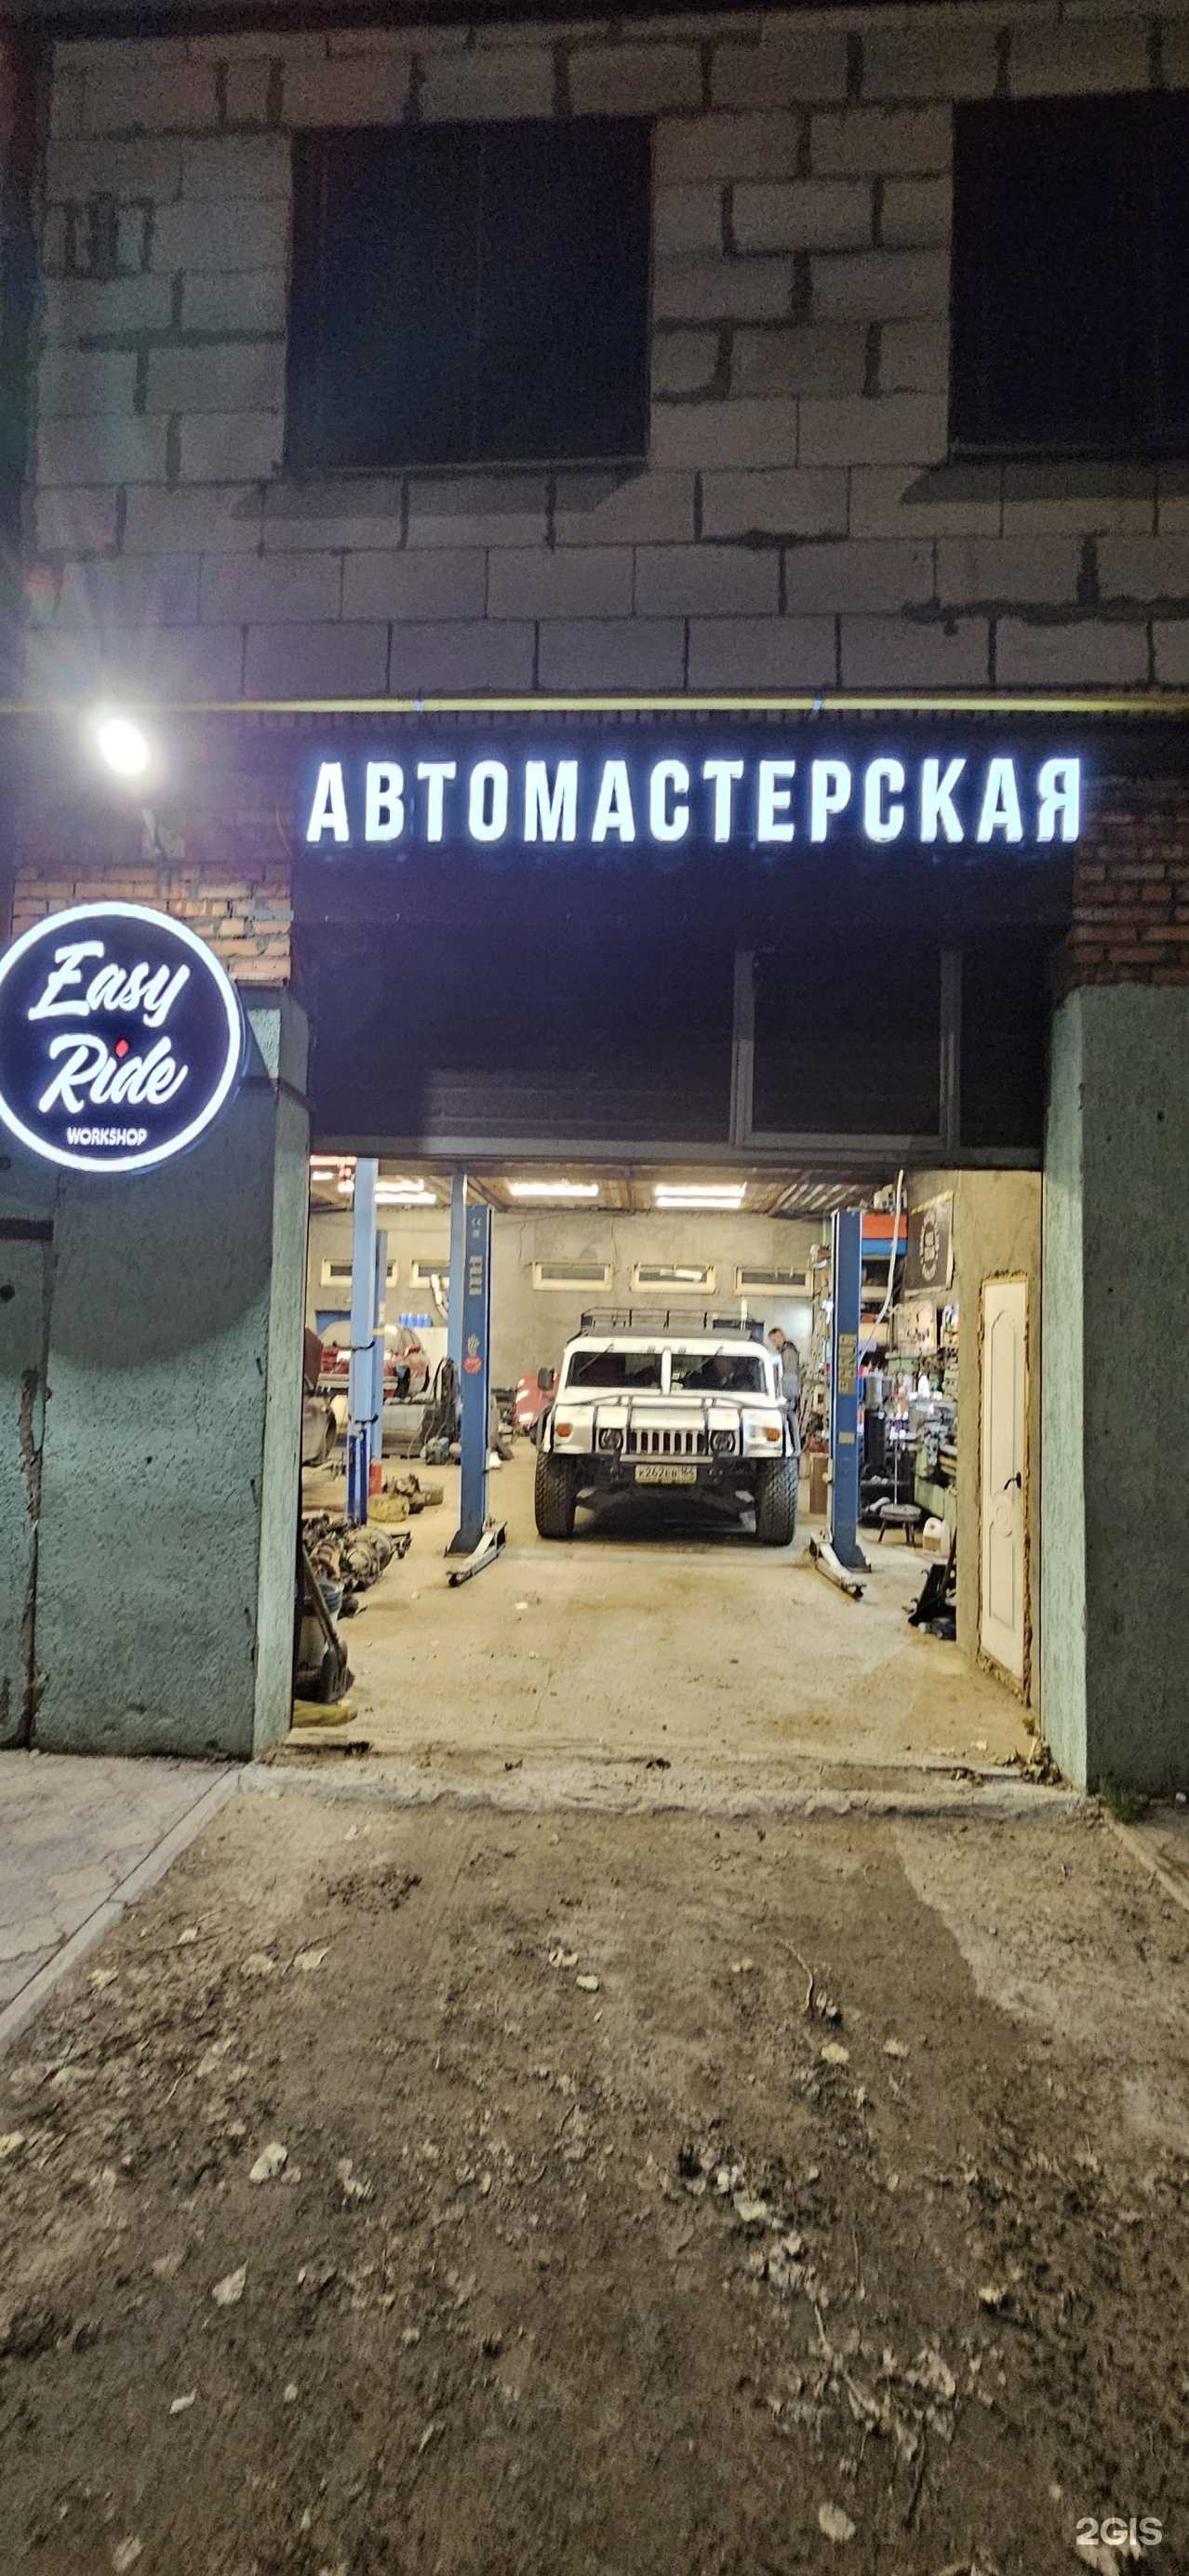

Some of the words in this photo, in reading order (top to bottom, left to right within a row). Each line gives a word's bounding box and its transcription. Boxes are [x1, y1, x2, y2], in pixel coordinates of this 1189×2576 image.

[306, 758, 1081, 843] АВТОМАСТЕРСКАЯ
[28, 941, 191, 1028] Easy
[38, 1033, 189, 1114] Ride
[66, 1126, 148, 1147] WORKSHOP
